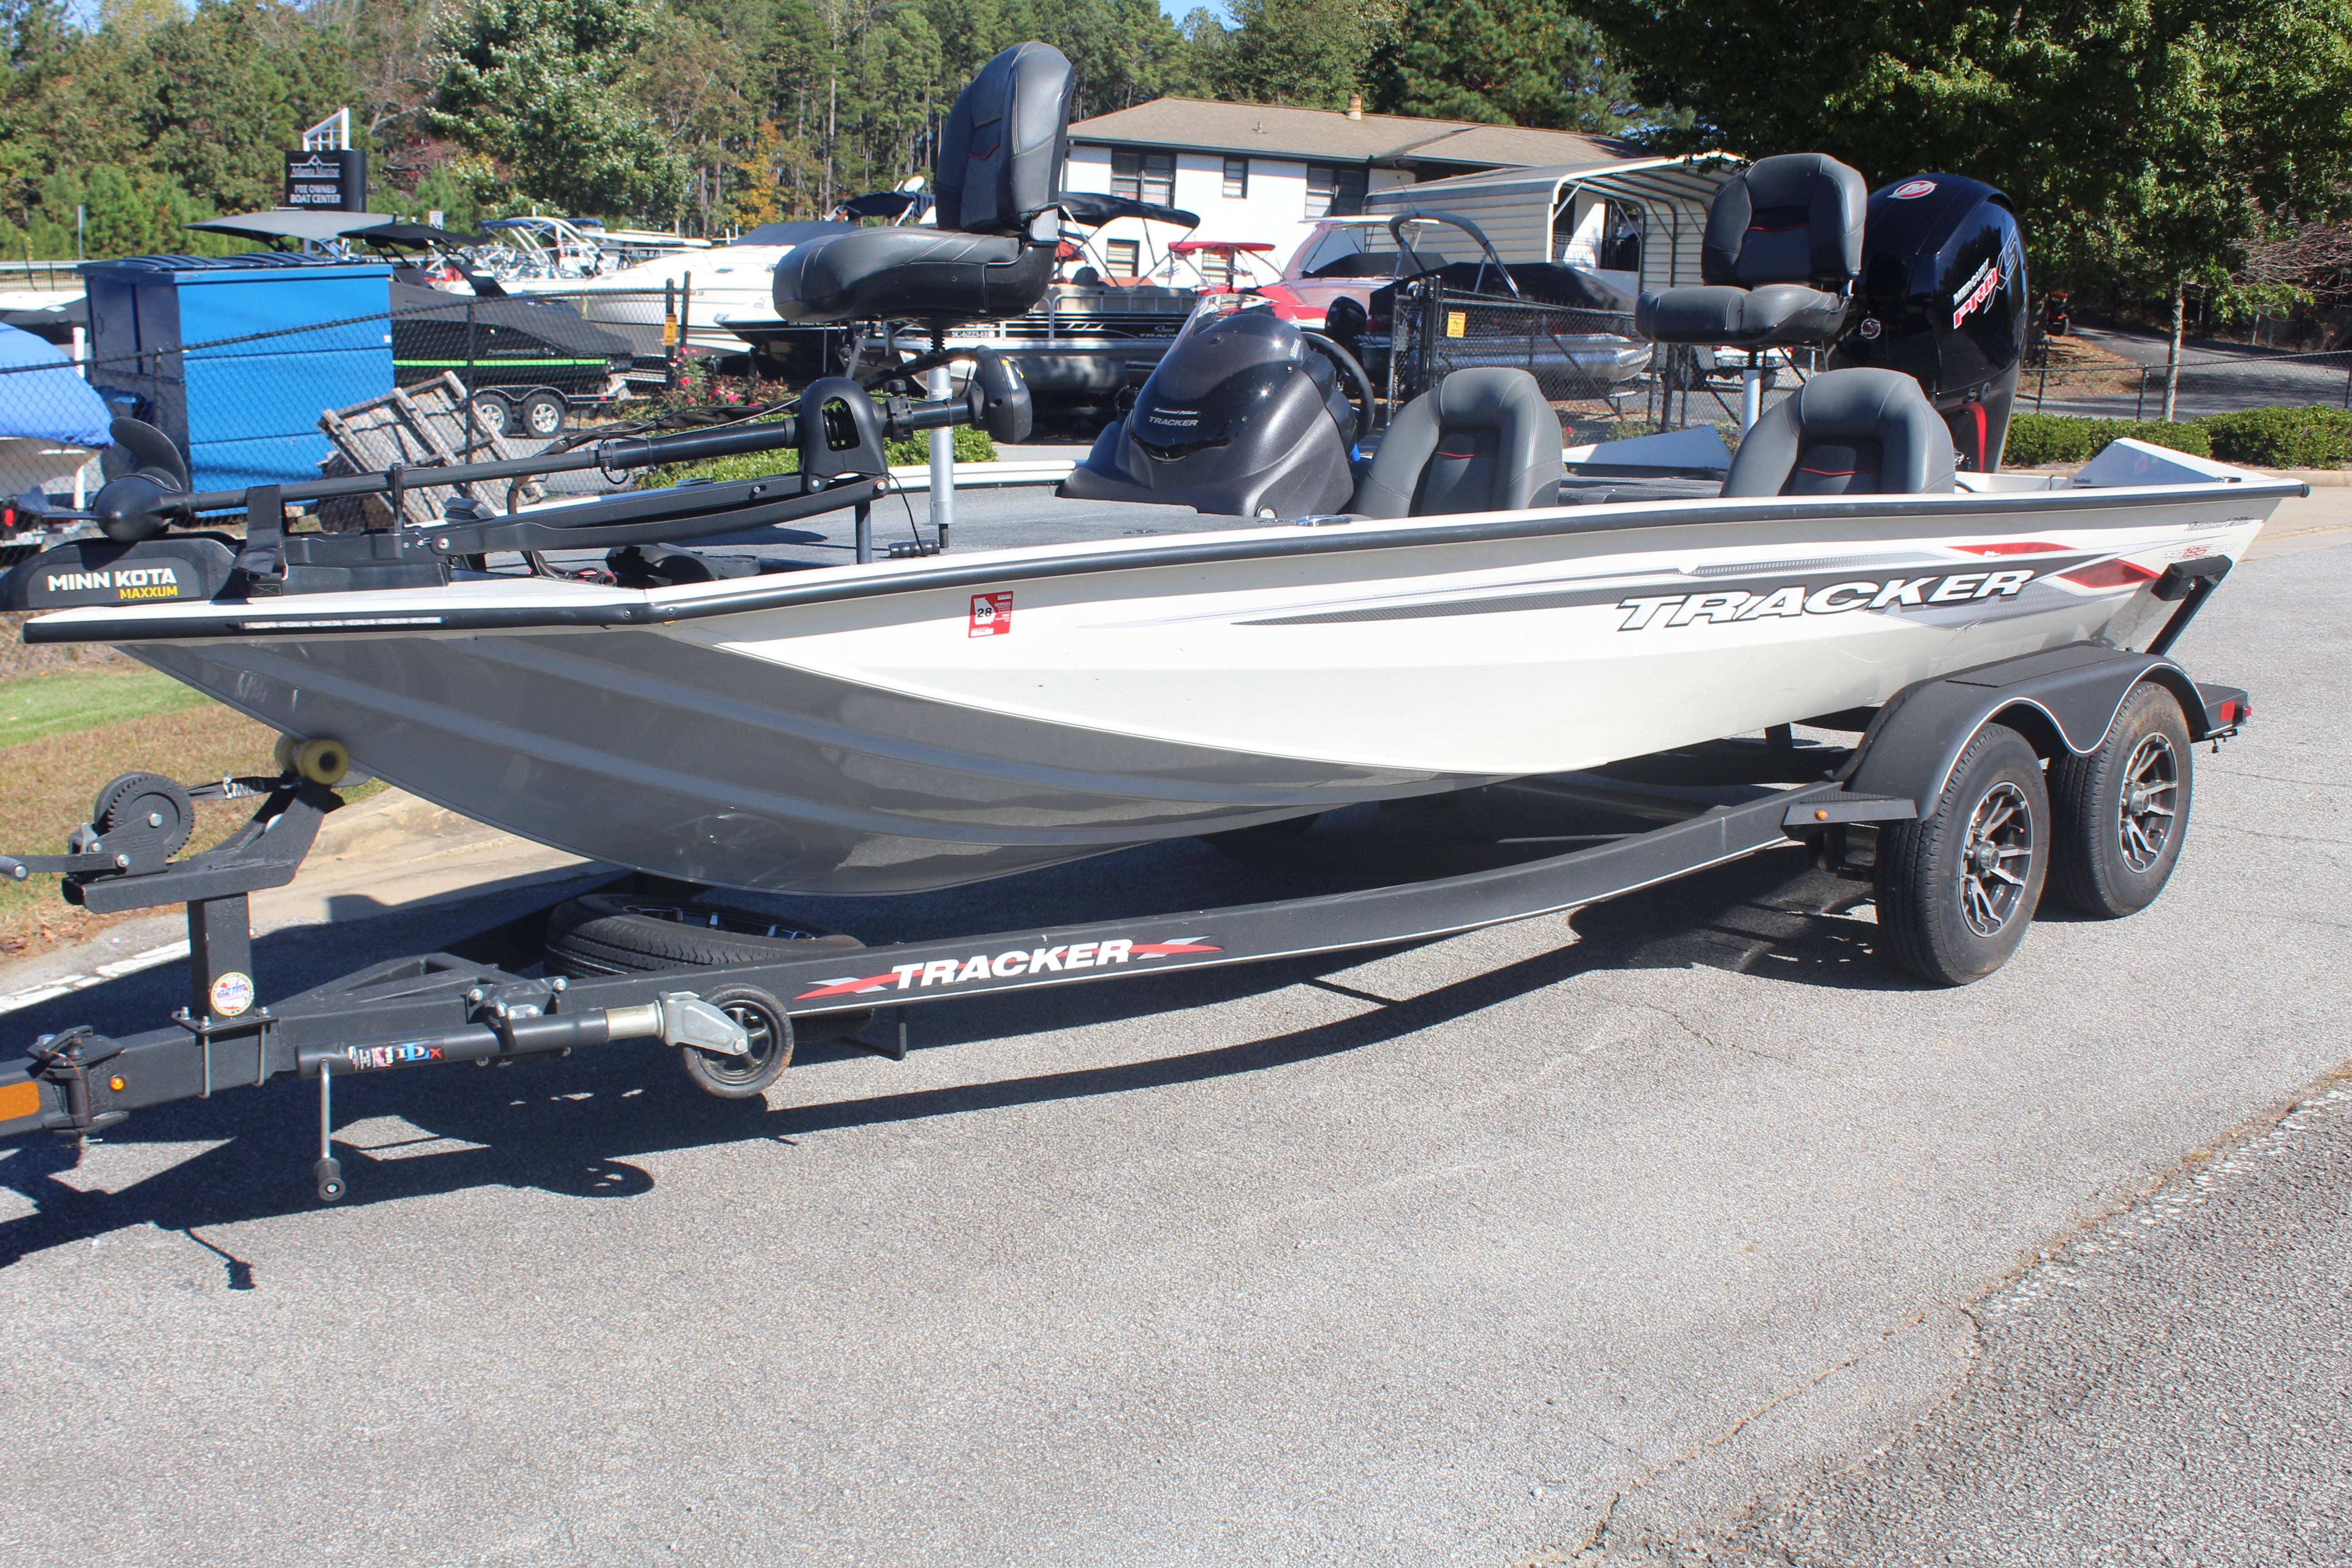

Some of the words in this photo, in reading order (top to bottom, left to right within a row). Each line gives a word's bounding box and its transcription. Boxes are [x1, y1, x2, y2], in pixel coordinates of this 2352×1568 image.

[295, 185, 308, 194] PRE
[309, 185, 337, 193] OWNED
[290, 194, 311, 203] BOAT
[312, 194, 341, 203] CENTER
[1953, 257, 1990, 305] MERCURY
[1953, 267, 1997, 329] PRO
[1149, 416, 1199, 426] TRACKER
[2181, 545, 2210, 558] 195
[47, 572, 111, 592] MINN
[114, 568, 177, 587] KOTA
[119, 585, 178, 600] MAXXUM
[1615, 569, 2035, 632] TRACKER
[977, 607, 992, 618] 28
[891, 939, 1133, 990] TRACKER
